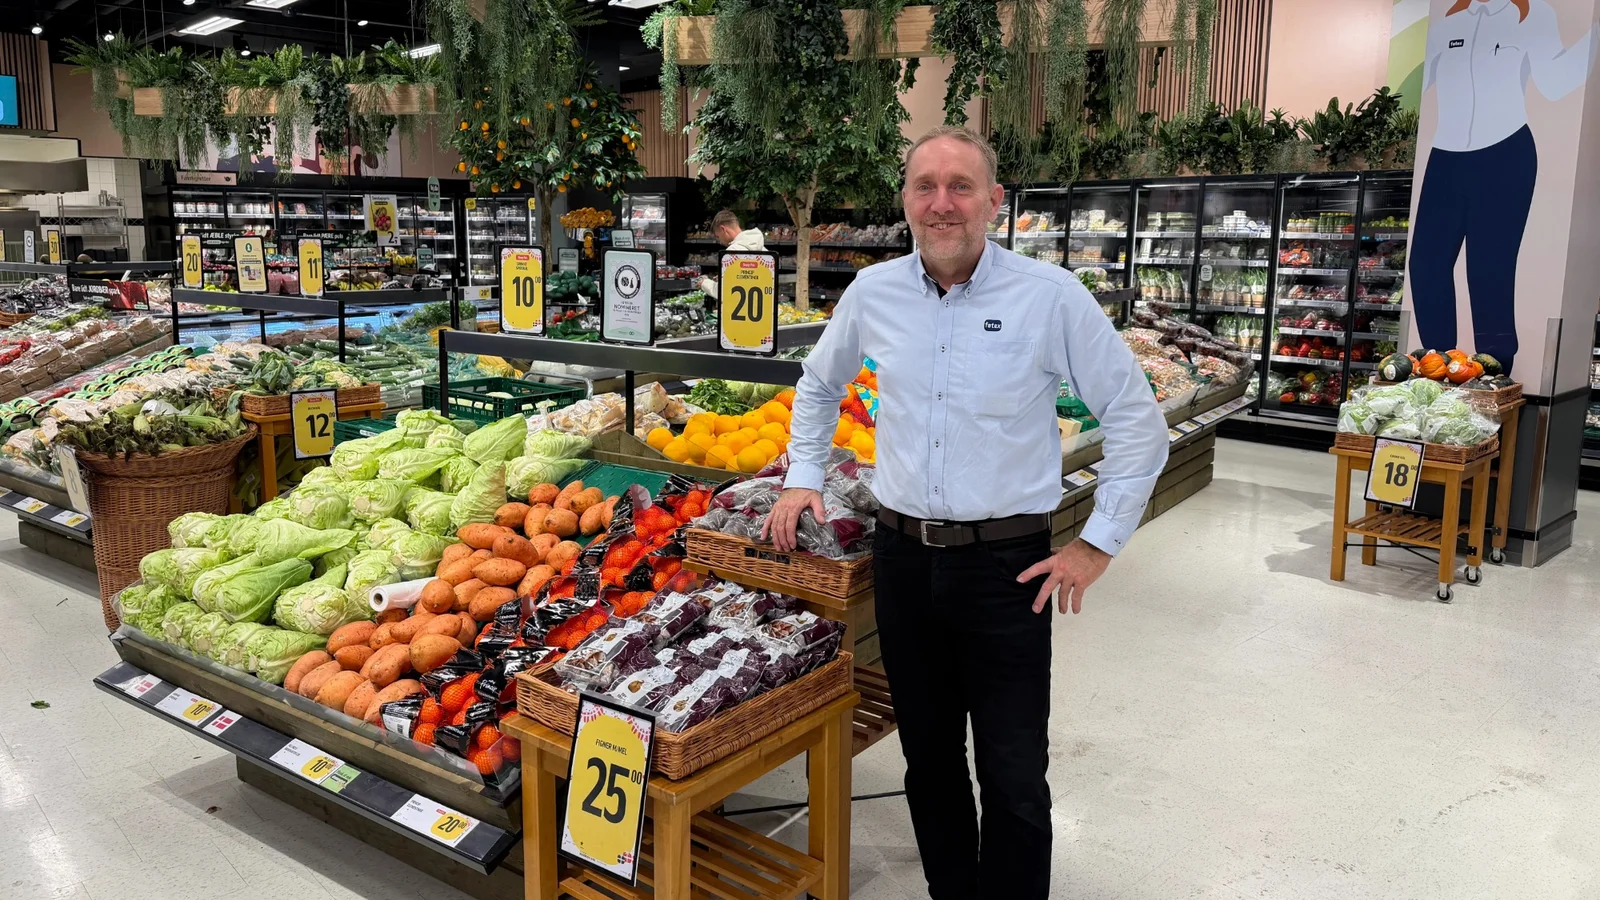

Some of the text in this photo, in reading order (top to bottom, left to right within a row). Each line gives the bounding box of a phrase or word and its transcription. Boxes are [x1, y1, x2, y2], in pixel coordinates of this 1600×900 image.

[186, 252, 198, 272] 20
[307, 257, 318, 279] 11
[512, 276, 535, 307] 10
[731, 285, 773, 322] 20 00
[305, 413, 330, 438] 12
[1384, 461, 1409, 487] 18
[190, 703, 207, 716] 10
[595, 738, 612, 750] FIGNER
[310, 759, 329, 773] 10
[581, 756, 643, 824] 25 00
[437, 816, 460, 833] 20
